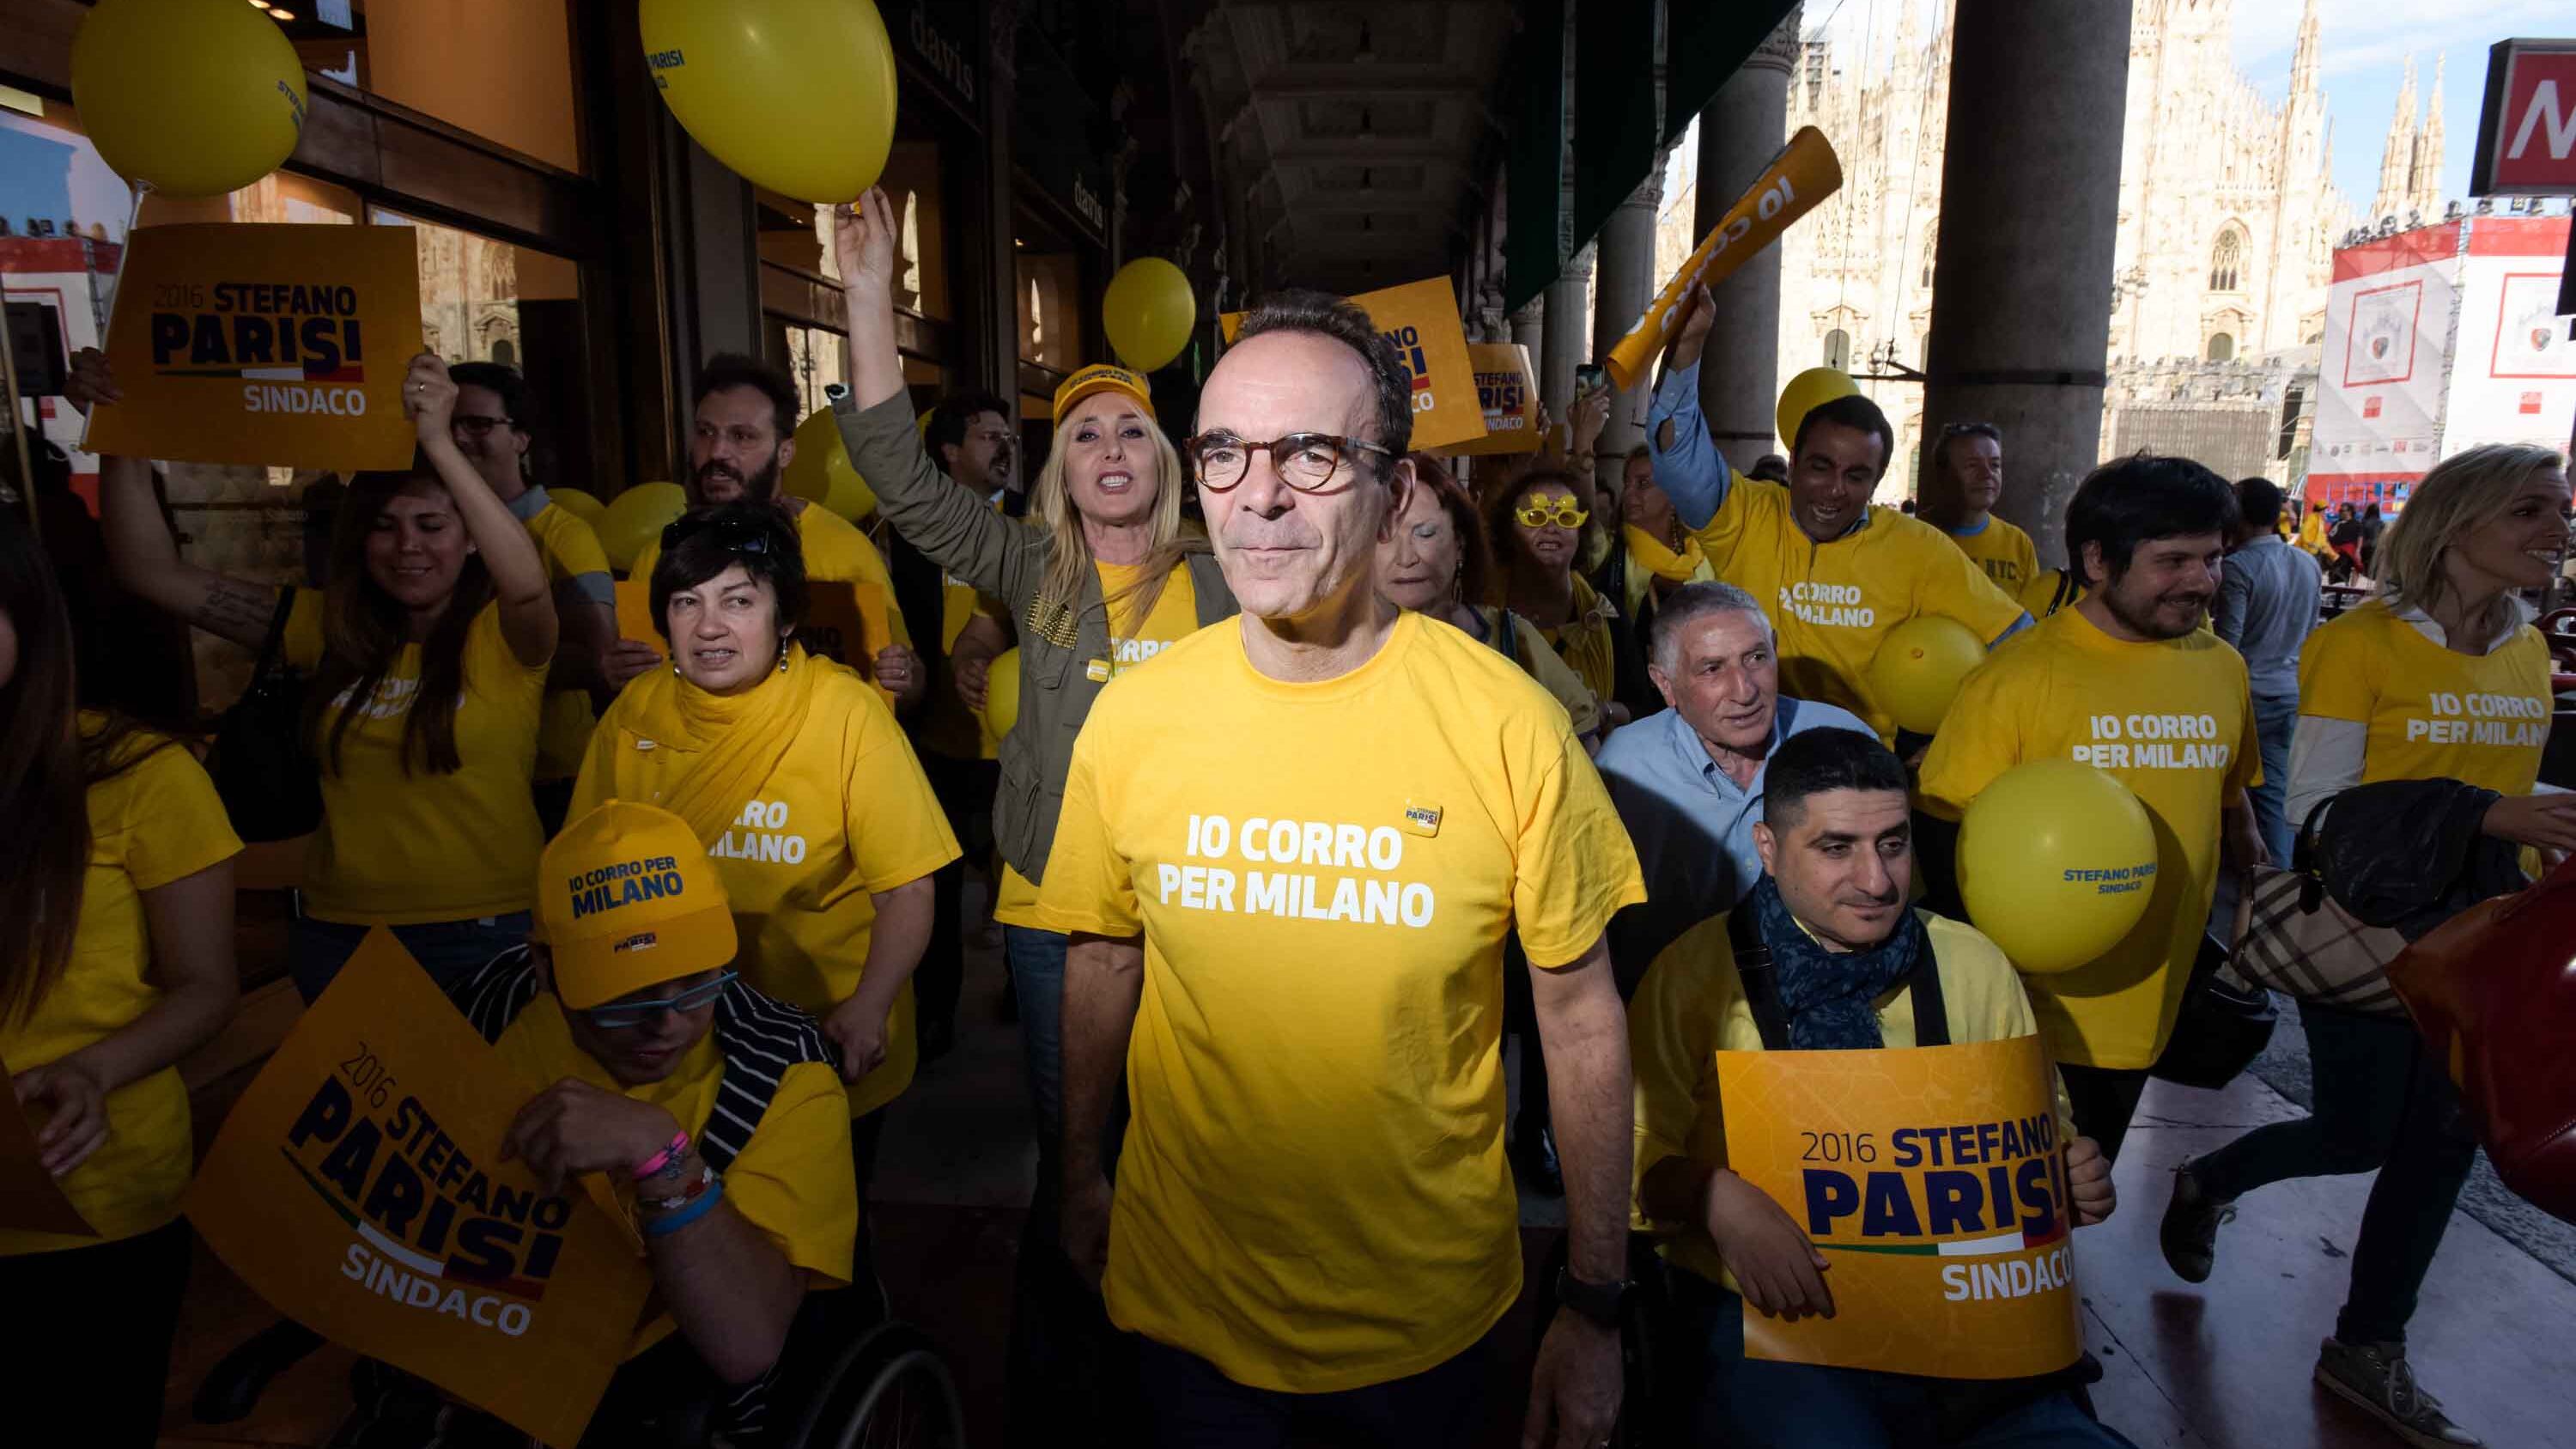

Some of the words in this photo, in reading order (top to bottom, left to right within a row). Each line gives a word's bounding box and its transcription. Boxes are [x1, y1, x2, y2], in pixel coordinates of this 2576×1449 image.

[1758, 175, 1795, 221] IO
[214, 283, 357, 316] STEFANO
[152, 313, 361, 375] PARISI
[243, 385, 367, 417] SINDACO
[1479, 387, 1525, 412] RISI
[1484, 417, 1523, 433] NDACO
[1793, 581, 1861, 606] CORRO
[2430, 692, 2462, 715] IO
[2465, 693, 2545, 719] CORRO
[2090, 715, 2122, 740] IO
[2125, 715, 2217, 740] CORRO
[2407, 718, 2470, 744] PER
[2471, 721, 2549, 746] MILAN
[2072, 744, 2130, 769] PER
[2134, 744, 2230, 769] MILANO
[1406, 809, 1437, 822] PARISI
[708, 831, 806, 864] ILANO
[1187, 814, 1230, 858] IO
[1240, 818, 1402, 871] CORRO
[568, 875, 584, 892] IO
[586, 861, 641, 886] CORRO
[644, 856, 676, 873] PER
[2063, 869, 2129, 882] STEFANO
[572, 872, 683, 919] MILANO
[1157, 862, 1236, 912] PER
[1245, 871, 1435, 928] MILANO
[340, 1041, 397, 1109] 2016
[386, 1095, 571, 1230] STEFANO
[1800, 1131, 1877, 1163] 2016
[1892, 1113, 2053, 1168] STEFANO
[289, 1074, 564, 1284] PARISI
[1802, 1154, 2063, 1237] PARISI
[340, 1243, 532, 1337] SINDACO
[1941, 1246, 2074, 1301] SINDACO
